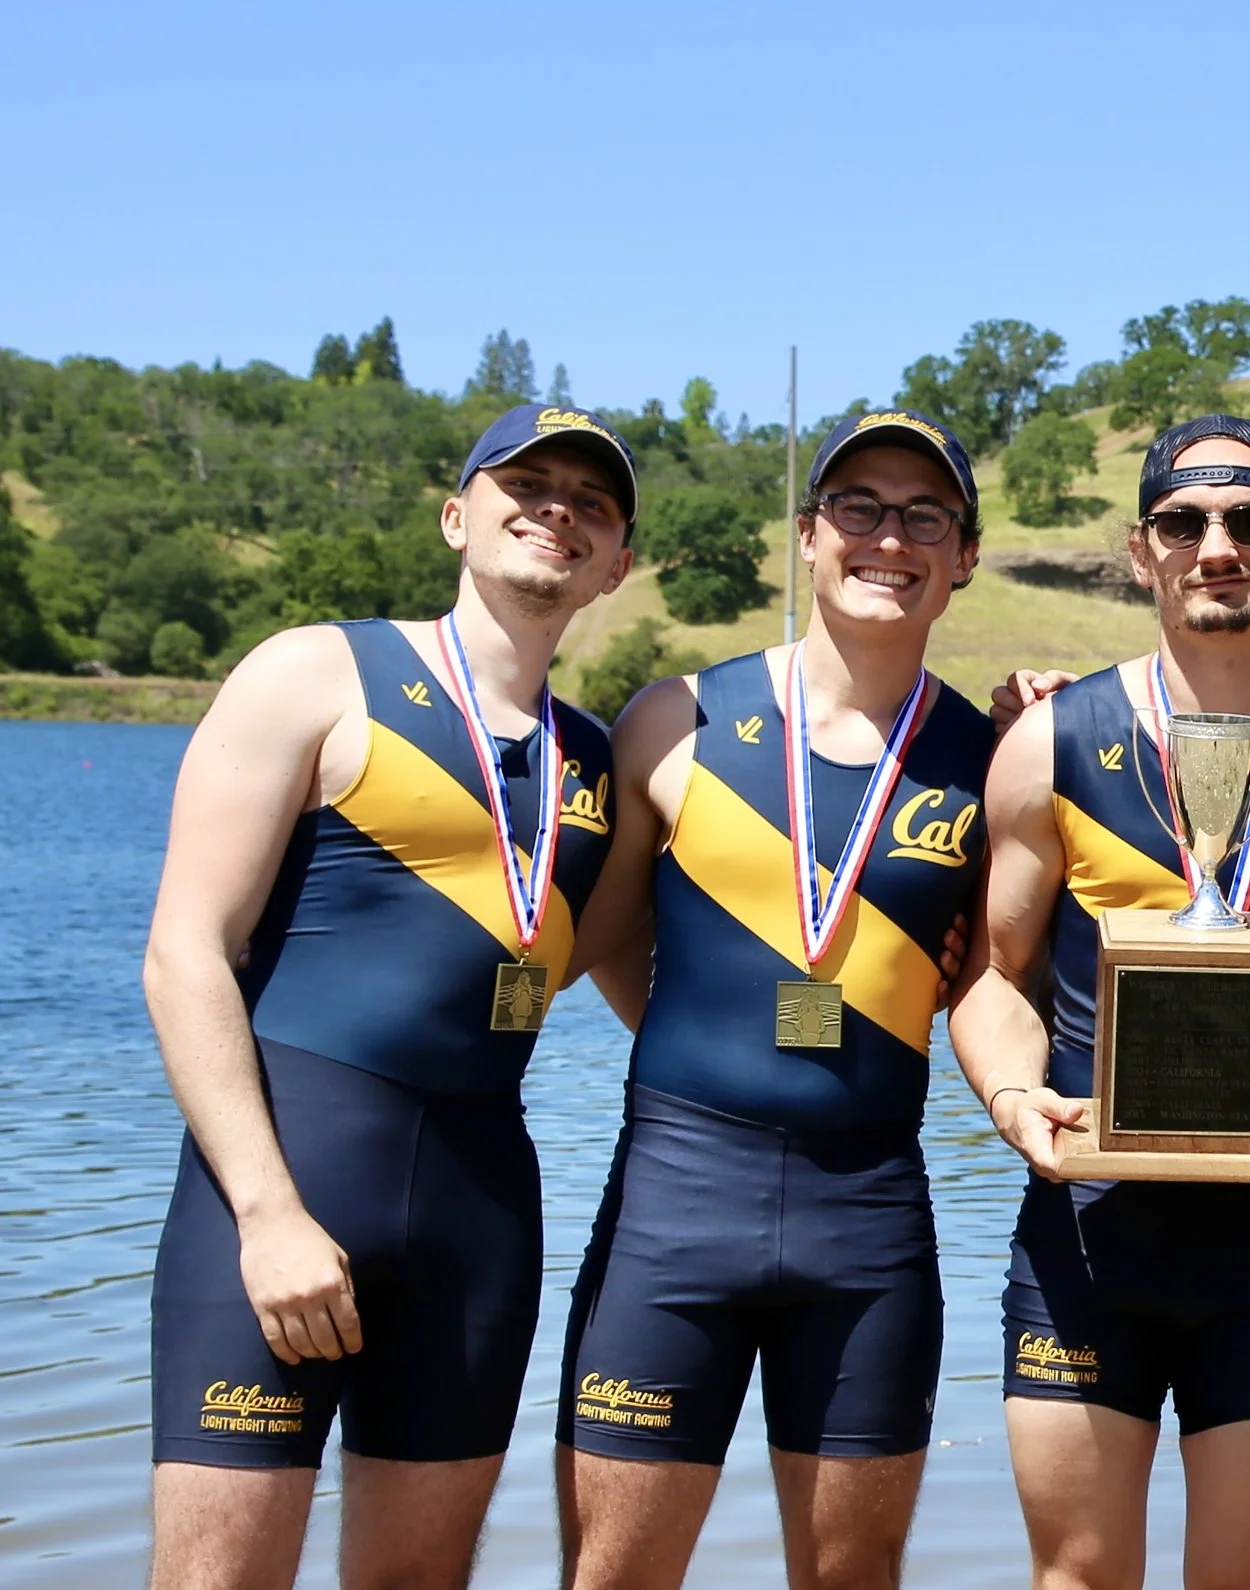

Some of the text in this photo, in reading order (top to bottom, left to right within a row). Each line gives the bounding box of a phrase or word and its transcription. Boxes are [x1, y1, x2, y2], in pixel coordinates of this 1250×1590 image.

[887, 788, 977, 867] Cal
[1160, 1067, 1222, 1079] CALIFORNIA
[1016, 1332, 1097, 1366] California
[1016, 1362, 1098, 1383] LIGHTWEIGHT ROWING
[200, 1380, 304, 1417] California
[577, 1372, 673, 1409] California
[200, 1414, 302, 1433] LIGHTWEIGHT ROWING
[576, 1401, 671, 1427] LIGHTWEIGHT ROWING
